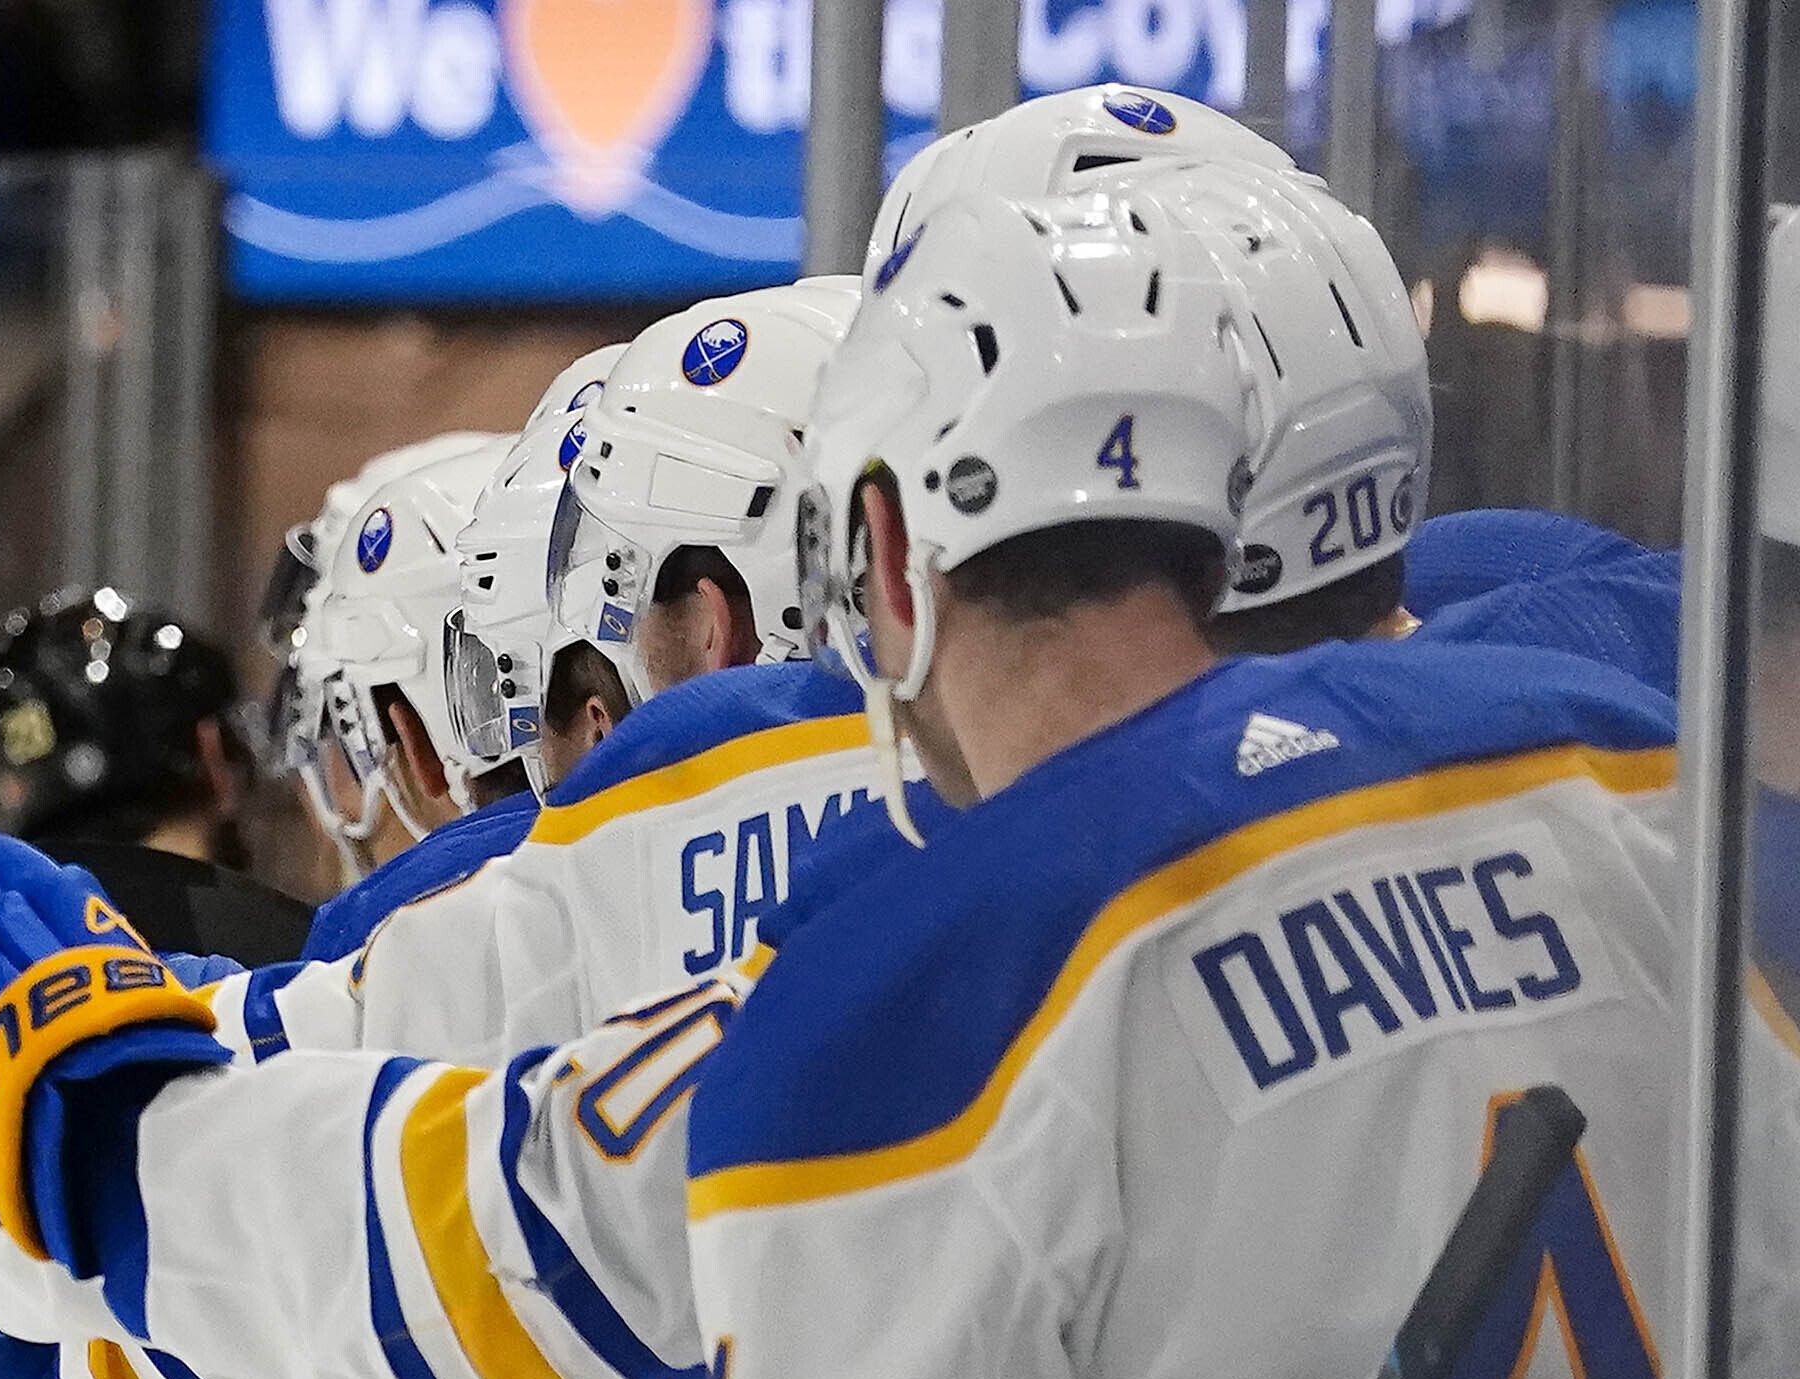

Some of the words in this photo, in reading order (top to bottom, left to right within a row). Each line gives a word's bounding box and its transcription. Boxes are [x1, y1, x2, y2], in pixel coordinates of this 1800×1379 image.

[1097, 413, 1141, 490] 4
[1302, 474, 1382, 566] 20
[1190, 850, 1582, 1090] DAVIES
